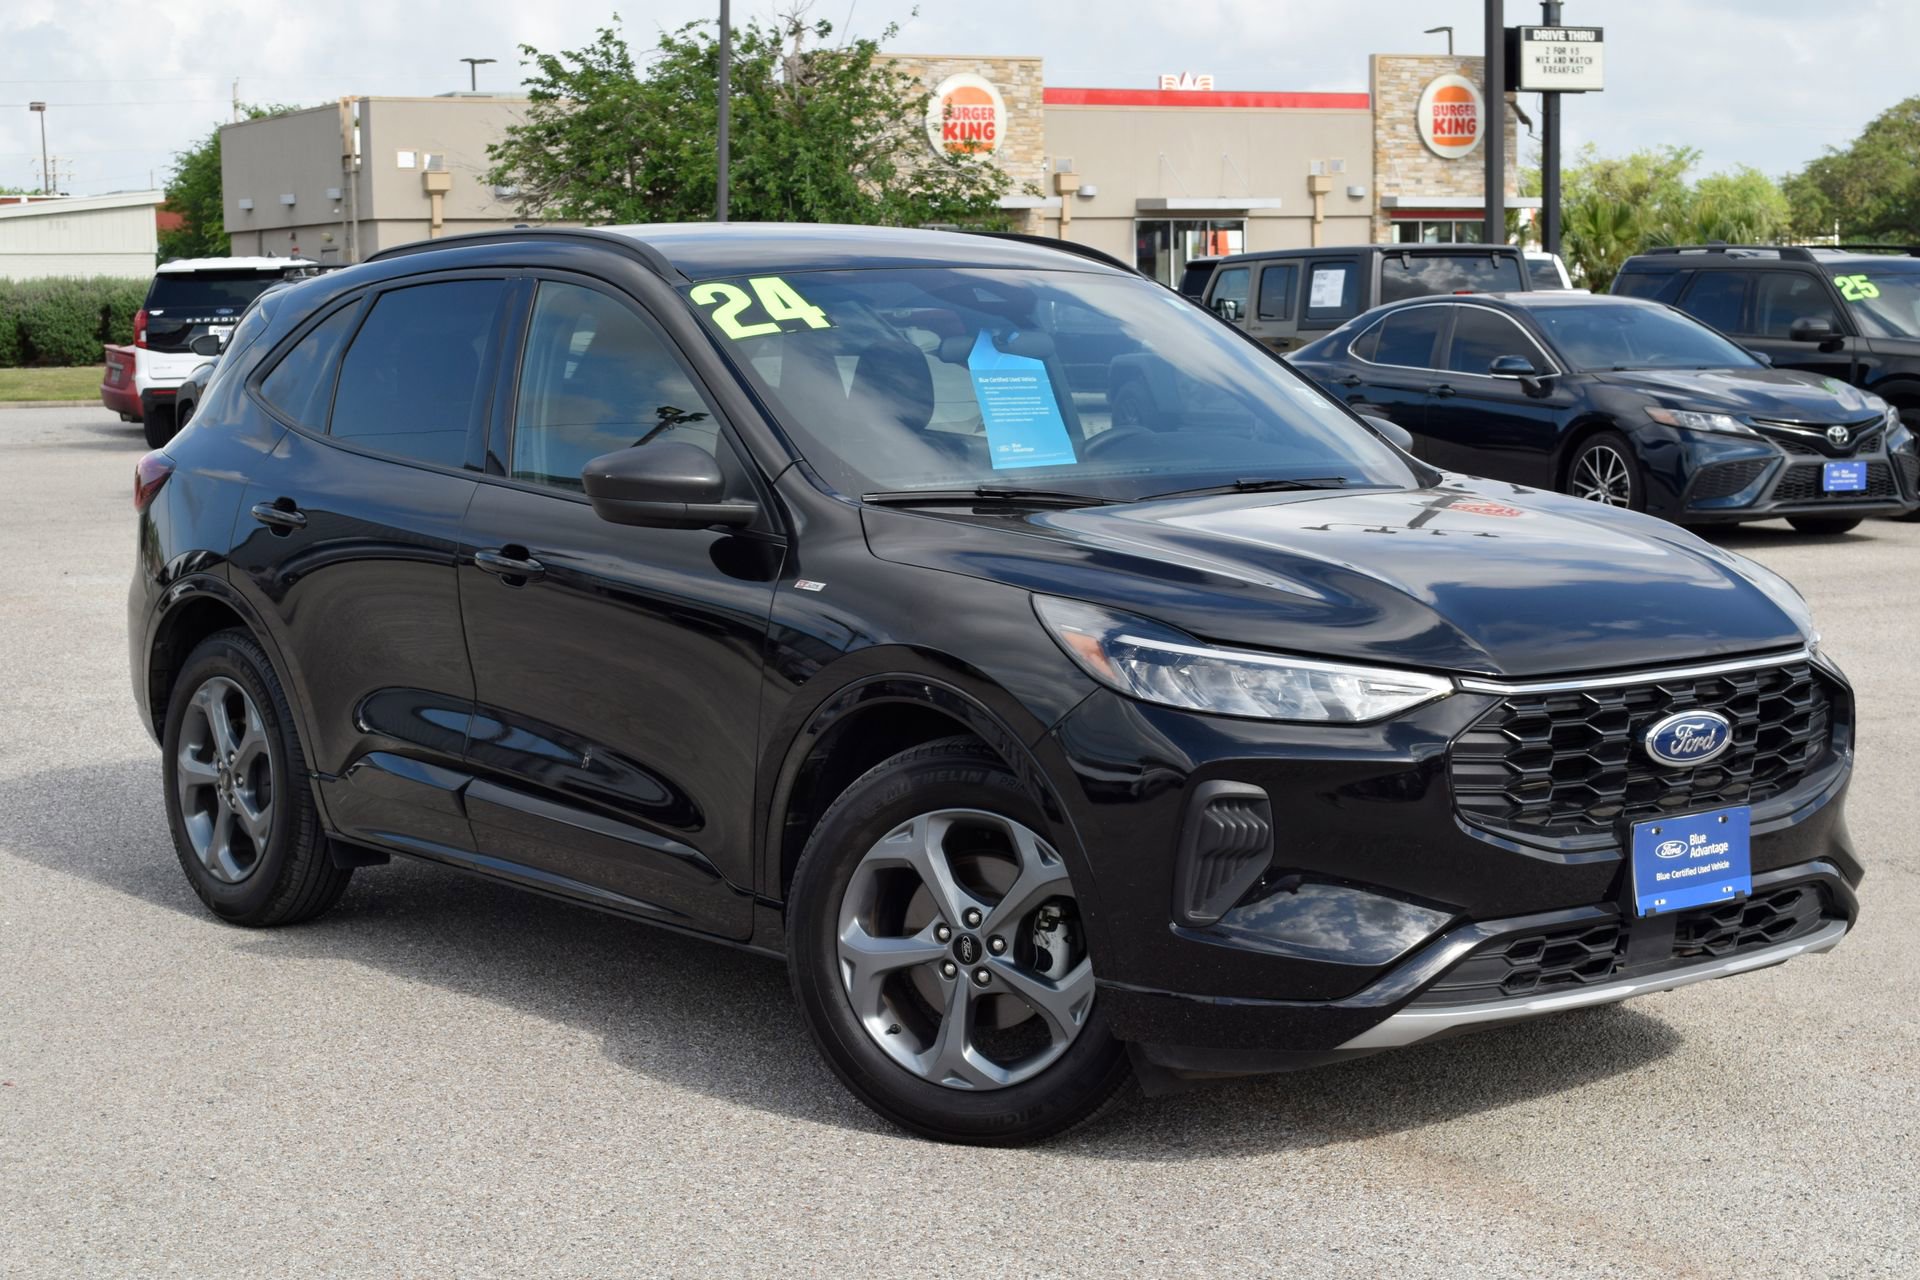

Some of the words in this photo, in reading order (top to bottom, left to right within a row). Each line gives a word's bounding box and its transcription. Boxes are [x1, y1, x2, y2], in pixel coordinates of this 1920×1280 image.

[1532, 29, 1566, 41] DRIVE
[1566, 30, 1596, 42] THRU
[1553, 46, 1567, 55] FOR
[1535, 56, 1550, 64] MIX
[1553, 56, 1567, 64] AND
[1569, 56, 1593, 65] MATCH
[1543, 65, 1584, 74] BREAKFAST
[1433, 104, 1477, 116] BURGER
[942, 122, 996, 141] KING
[1433, 118, 1477, 135] KING
[1833, 274, 1880, 302] 25
[689, 277, 832, 340] 24
[1670, 723, 1716, 755] Ford
[1689, 833, 1707, 846] Blue
[1689, 842, 1729, 859] Advantage
[1656, 871, 1671, 881] Blue
[1671, 866, 1697, 879] Certified
[1697, 863, 1711, 874] Used
[1710, 860, 1730, 871] Vehicle
